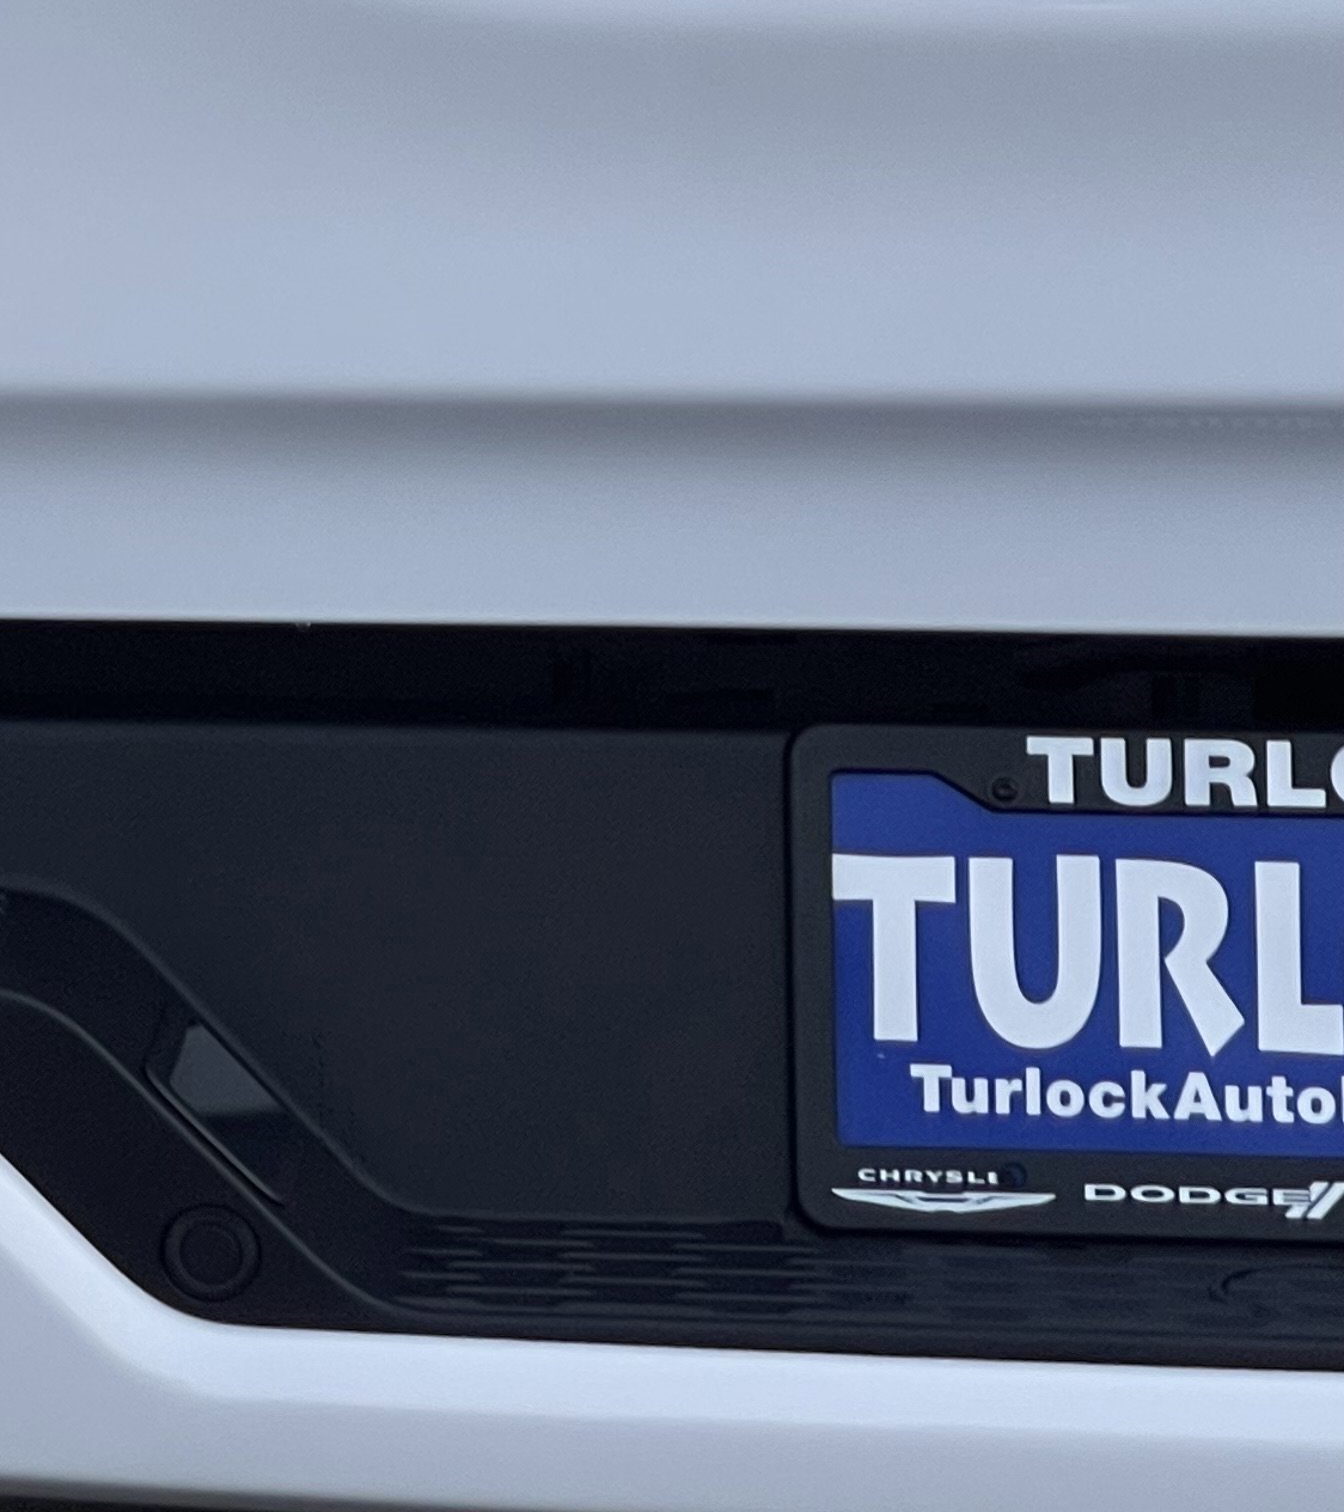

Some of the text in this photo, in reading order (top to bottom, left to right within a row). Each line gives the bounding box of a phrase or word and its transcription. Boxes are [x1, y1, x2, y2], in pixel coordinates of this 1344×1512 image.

[1026, 735, 1344, 808] TURL
[831, 853, 1344, 1057] TURL
[910, 1063, 1344, 1125] TurlockAuto
[1083, 1182, 1313, 1207] DODGE
